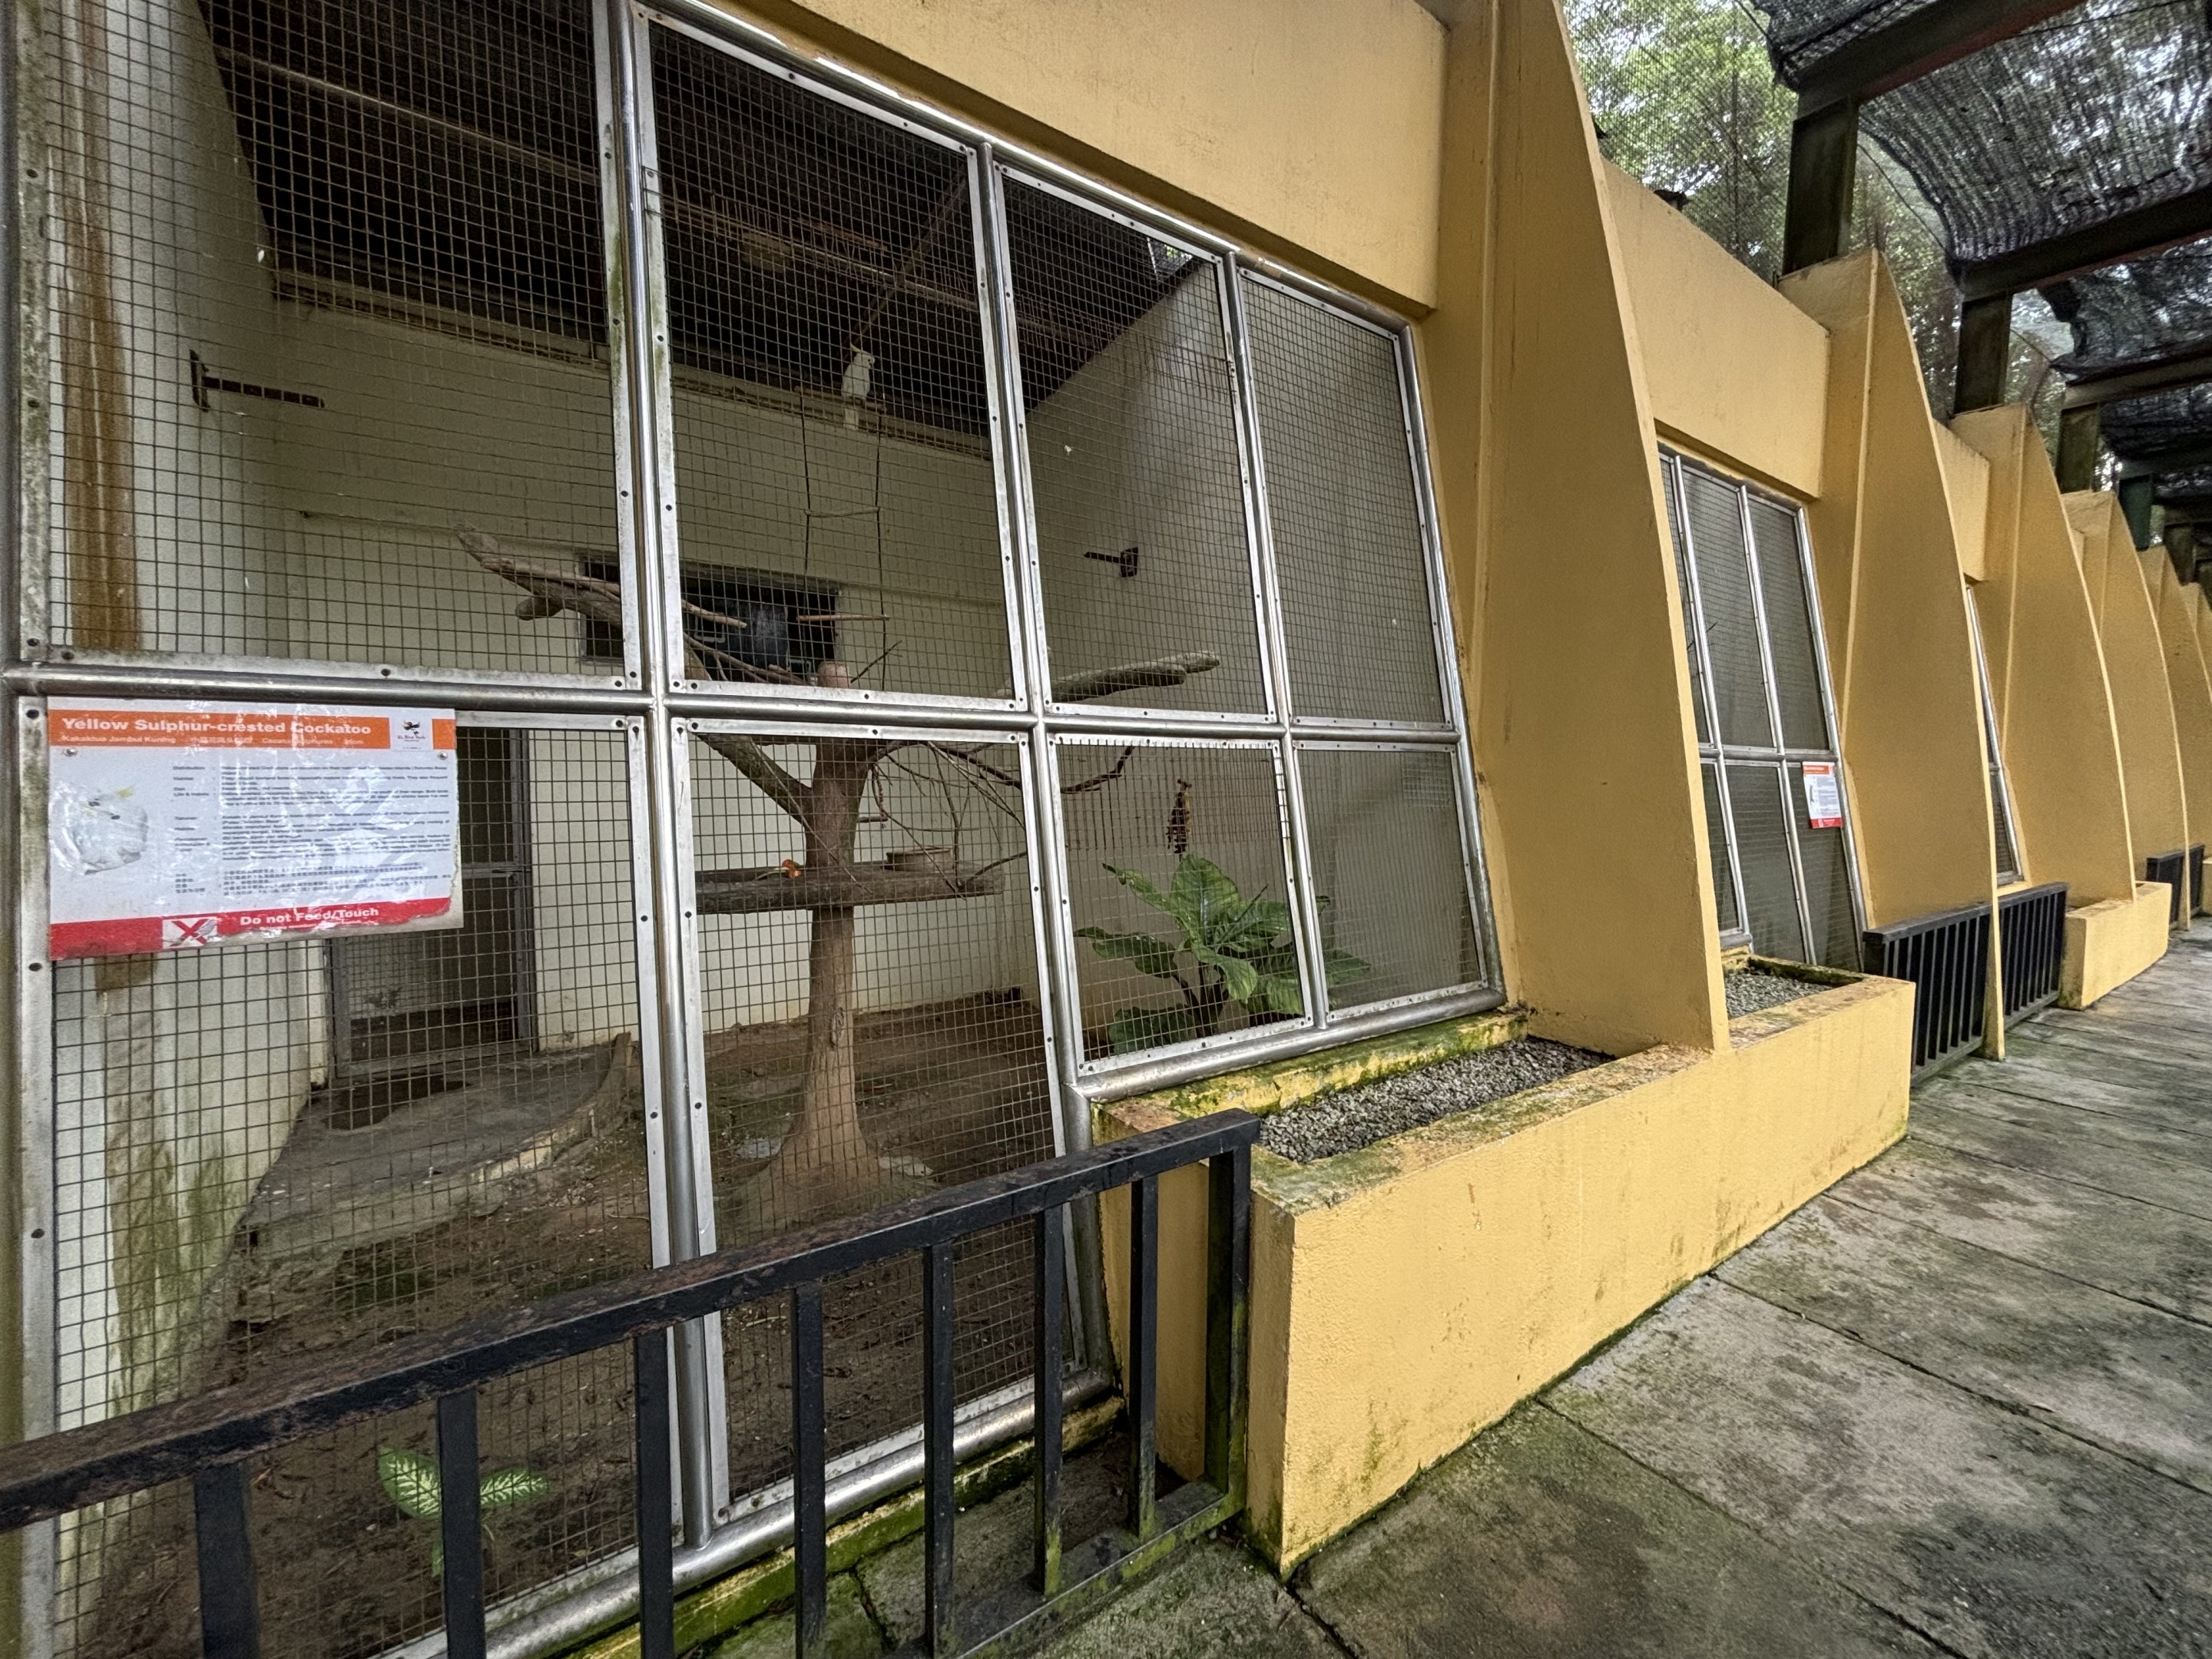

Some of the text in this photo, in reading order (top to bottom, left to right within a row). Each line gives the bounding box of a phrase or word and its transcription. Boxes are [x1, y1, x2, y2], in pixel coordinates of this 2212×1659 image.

[62, 717, 372, 734] Yellow Sulphur-crested Cockatoo
[240, 907, 379, 926] Do not Feed/Touch
